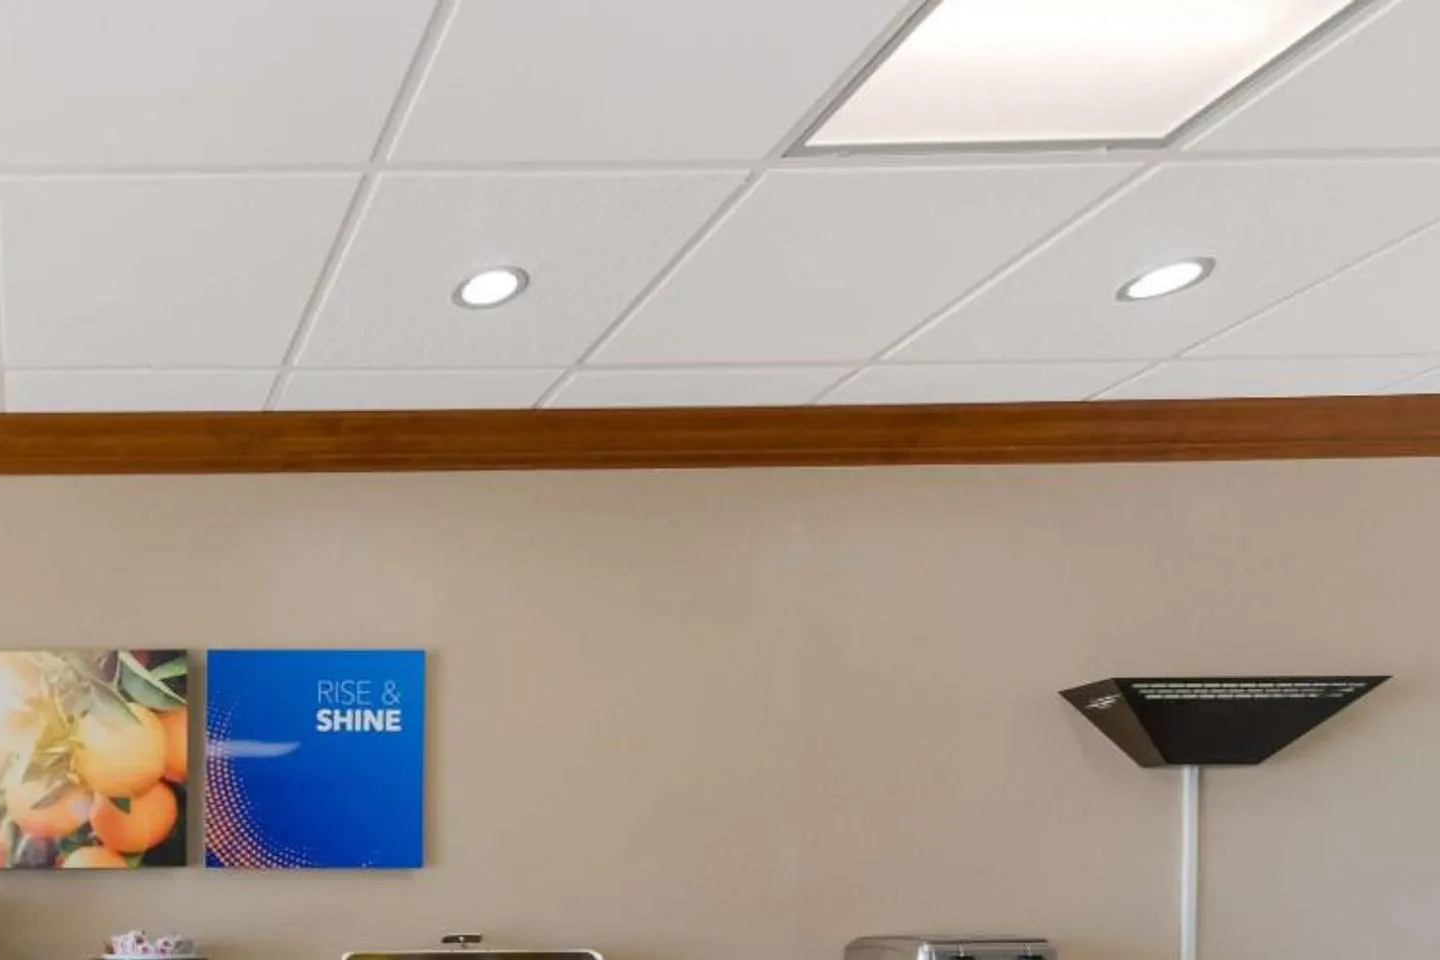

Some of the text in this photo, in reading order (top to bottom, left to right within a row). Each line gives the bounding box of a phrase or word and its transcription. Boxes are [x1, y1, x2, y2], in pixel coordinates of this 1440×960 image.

[318, 680, 401, 705] RISE &
[316, 708, 402, 732] SHINE
